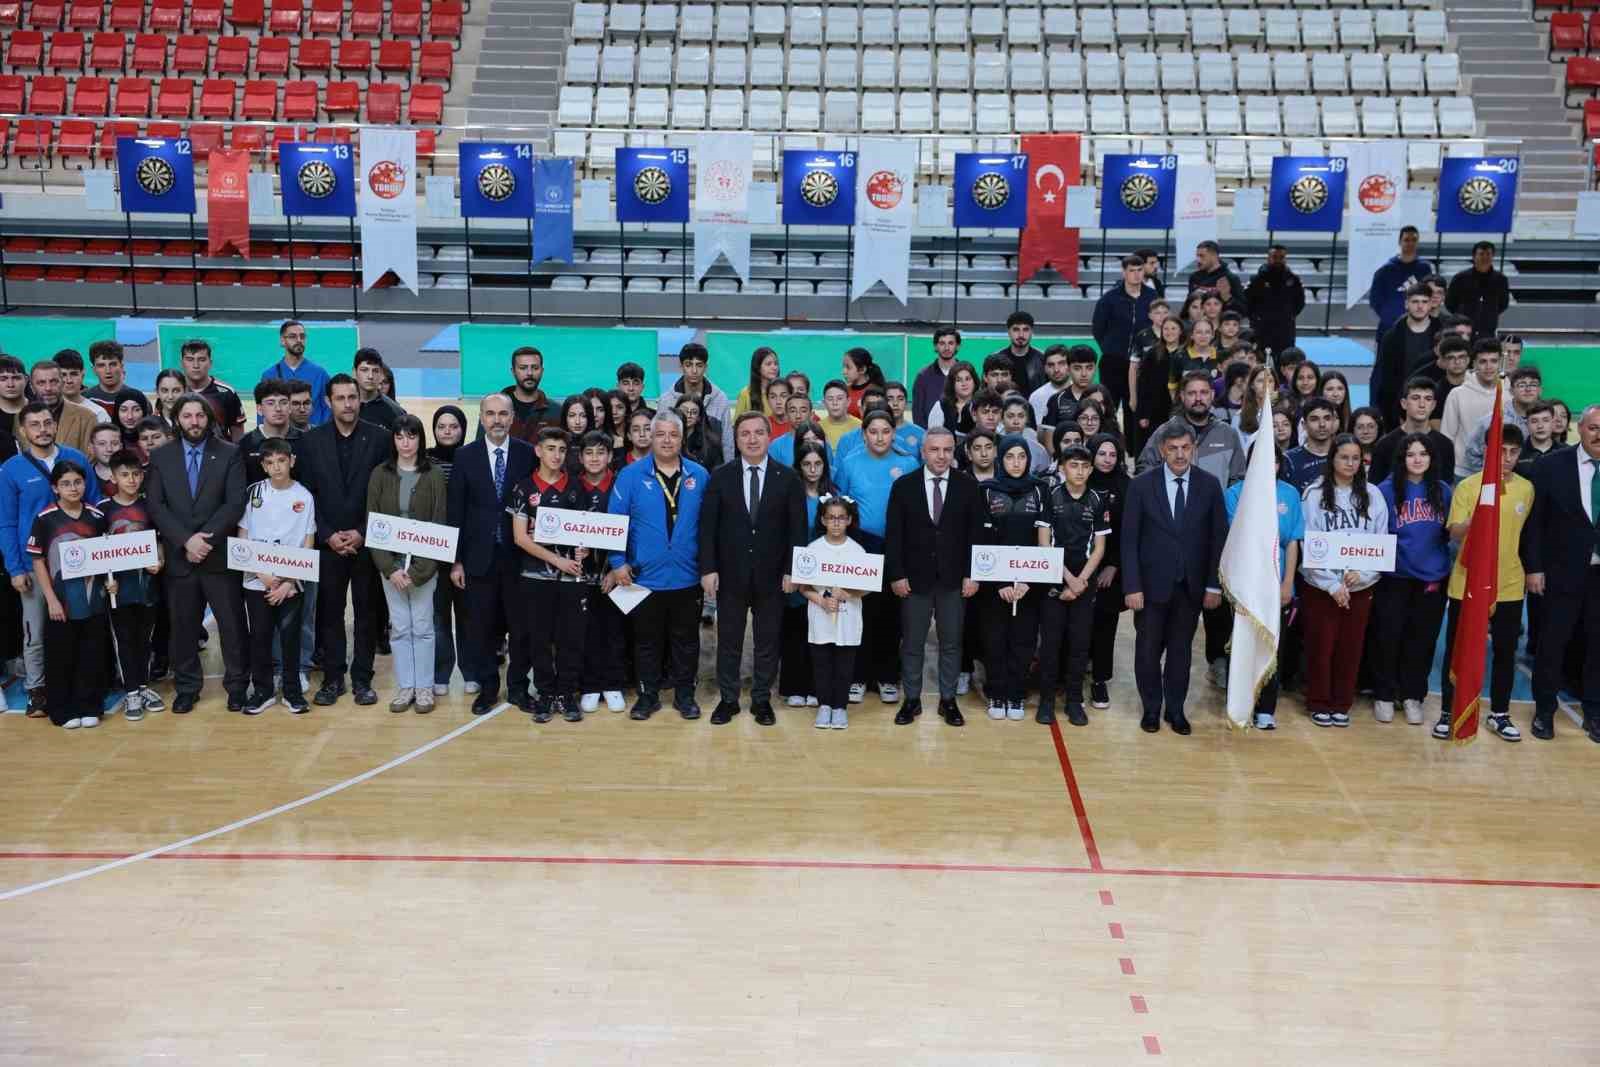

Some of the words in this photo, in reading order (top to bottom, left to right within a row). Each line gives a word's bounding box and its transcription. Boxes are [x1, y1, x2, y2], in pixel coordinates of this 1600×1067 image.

[174, 140, 191, 155] 12
[332, 144, 349, 159] 13
[514, 144, 530, 159] 14
[670, 144, 687, 159] 15
[837, 153, 854, 168] 16
[1010, 155, 1026, 169] 17
[1159, 156, 1176, 170] 18
[1327, 158, 1345, 173] 19
[1497, 158, 1517, 173] 20
[563, 522, 625, 537] GAZIANTEP
[91, 543, 152, 561] KIRIKKALE
[1339, 545, 1384, 558] DENIZLI
[257, 553, 313, 569] KARAMAN
